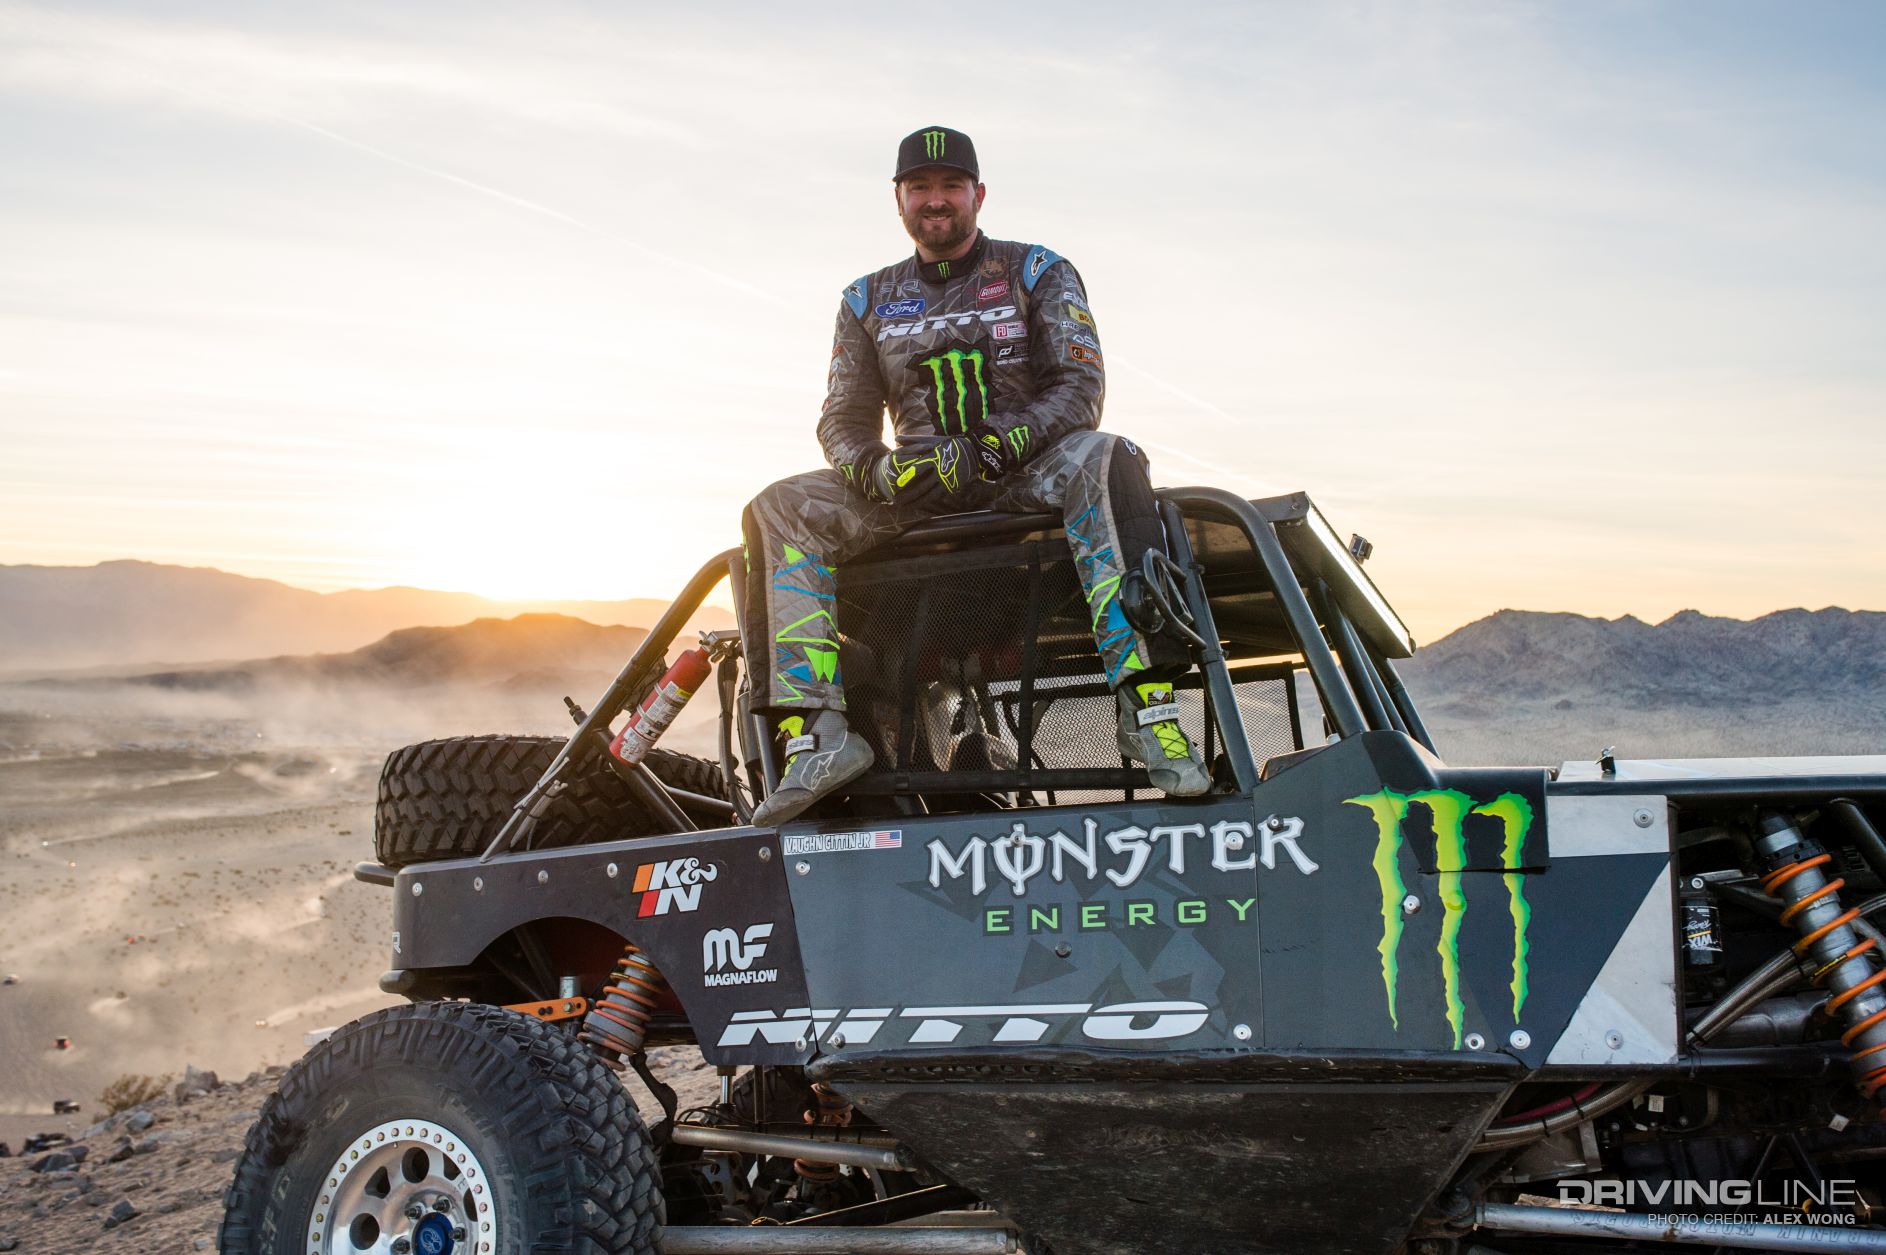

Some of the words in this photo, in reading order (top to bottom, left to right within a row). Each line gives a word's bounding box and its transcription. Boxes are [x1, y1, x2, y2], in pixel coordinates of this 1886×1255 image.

[877, 305, 1017, 342] NITTO
[885, 301, 919, 315] Ford
[785, 834, 822, 853] VAUGHN
[825, 832, 856, 850] GITTIN
[858, 832, 871, 848] JR
[928, 817, 1319, 896] MONSTER
[986, 898, 1256, 932] ENERGY
[704, 968, 778, 987] MAGNAFLOW
[717, 1001, 1209, 1047] NITTO
